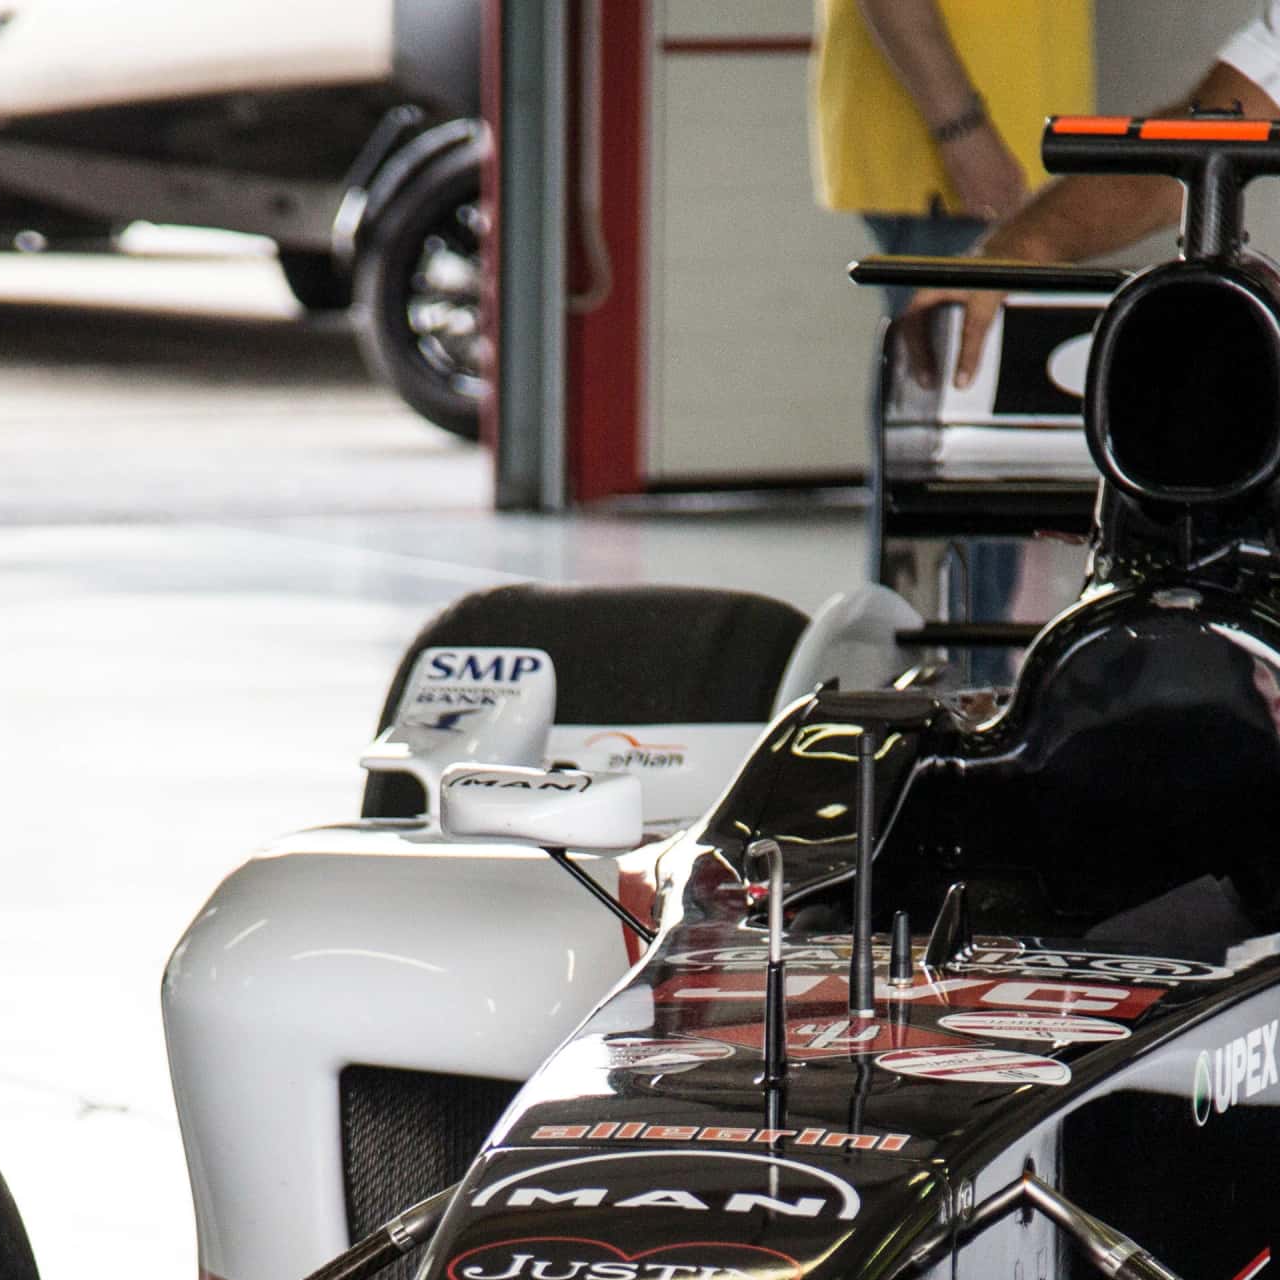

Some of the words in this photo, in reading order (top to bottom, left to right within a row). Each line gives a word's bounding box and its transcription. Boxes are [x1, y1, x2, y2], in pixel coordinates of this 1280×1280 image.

[426, 652, 542, 683] SMP
[460, 776, 577, 792] MAN
[673, 975, 1131, 1012] JVC
[506, 1187, 827, 1217] MAN
